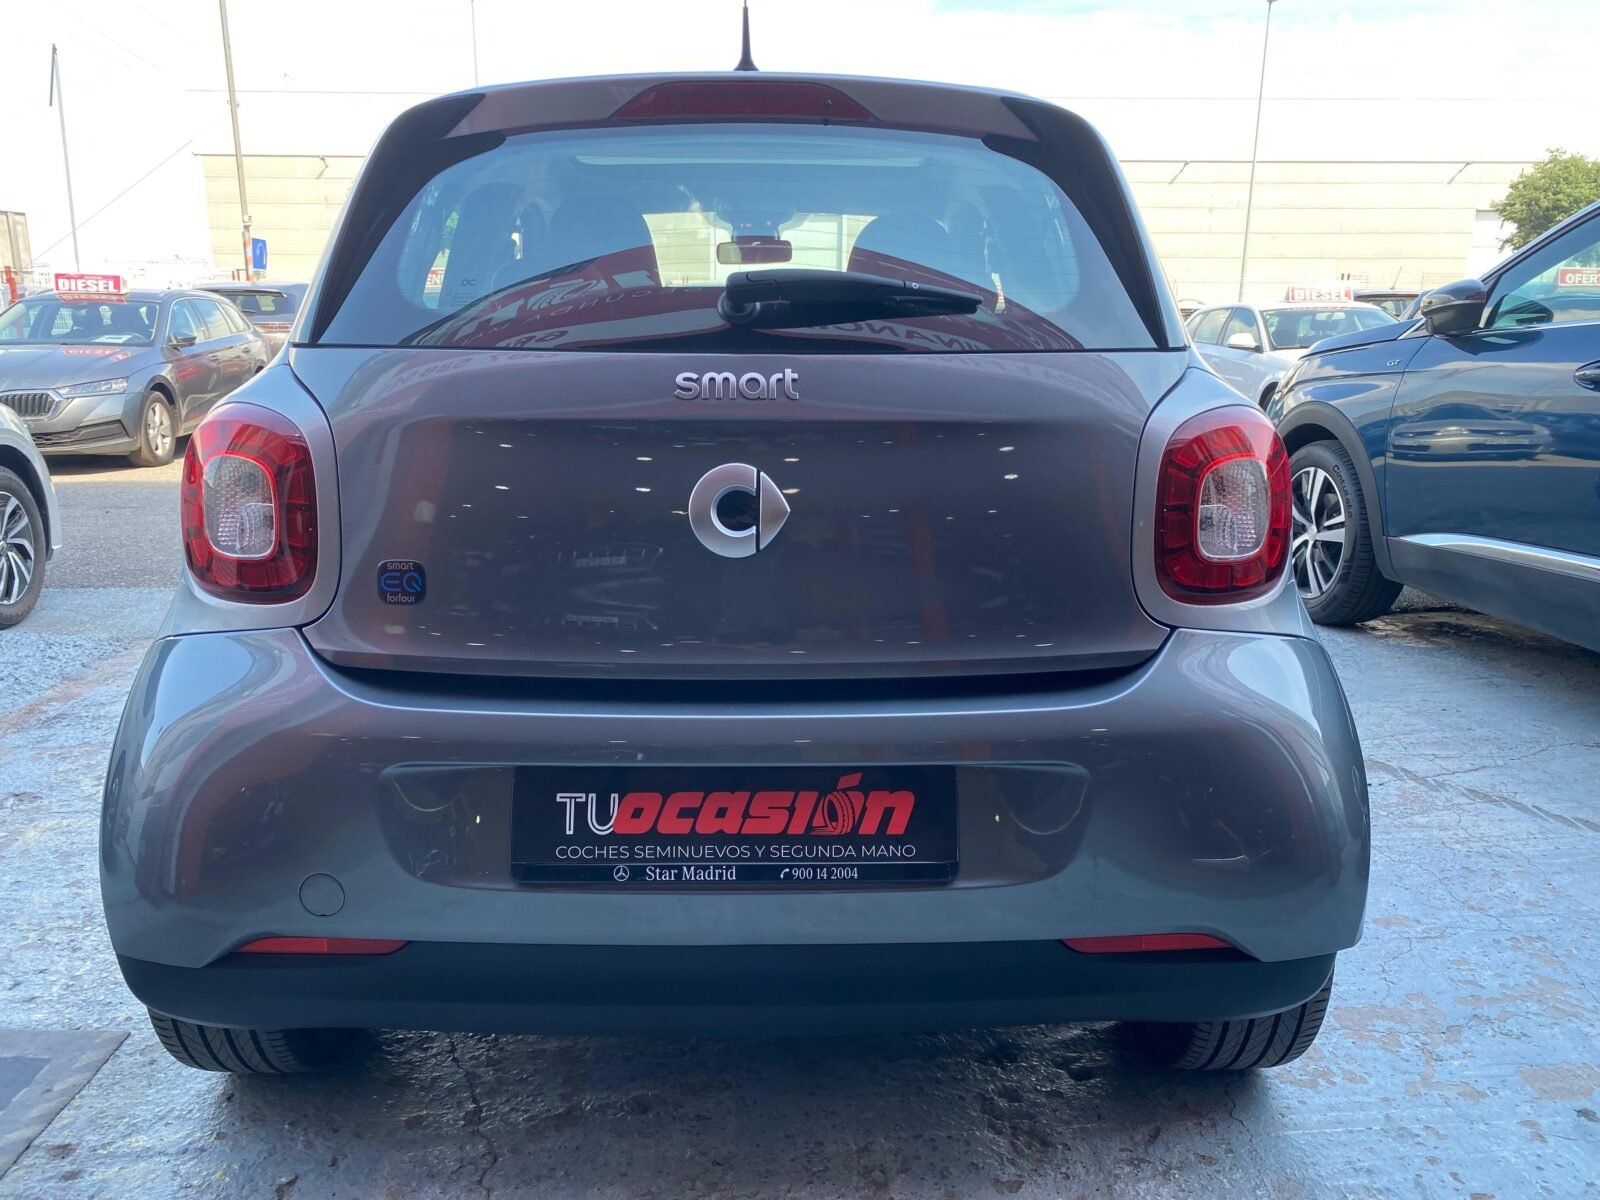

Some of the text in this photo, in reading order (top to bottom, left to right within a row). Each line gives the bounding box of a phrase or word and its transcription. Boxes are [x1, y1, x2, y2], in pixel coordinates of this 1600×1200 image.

[57, 278, 118, 292] DIESEL
[1566, 273, 1600, 284] OFER
[1294, 287, 1349, 301] DIESEL
[674, 368, 799, 400] smart
[387, 562, 414, 570] smart
[380, 572, 422, 592] EQ
[386, 593, 416, 602] forfour
[556, 844, 916, 859] COCHES SEMINUEVOS Y SEGUNDA MANO
[645, 865, 859, 881] Star Madrid 900 14 2004
